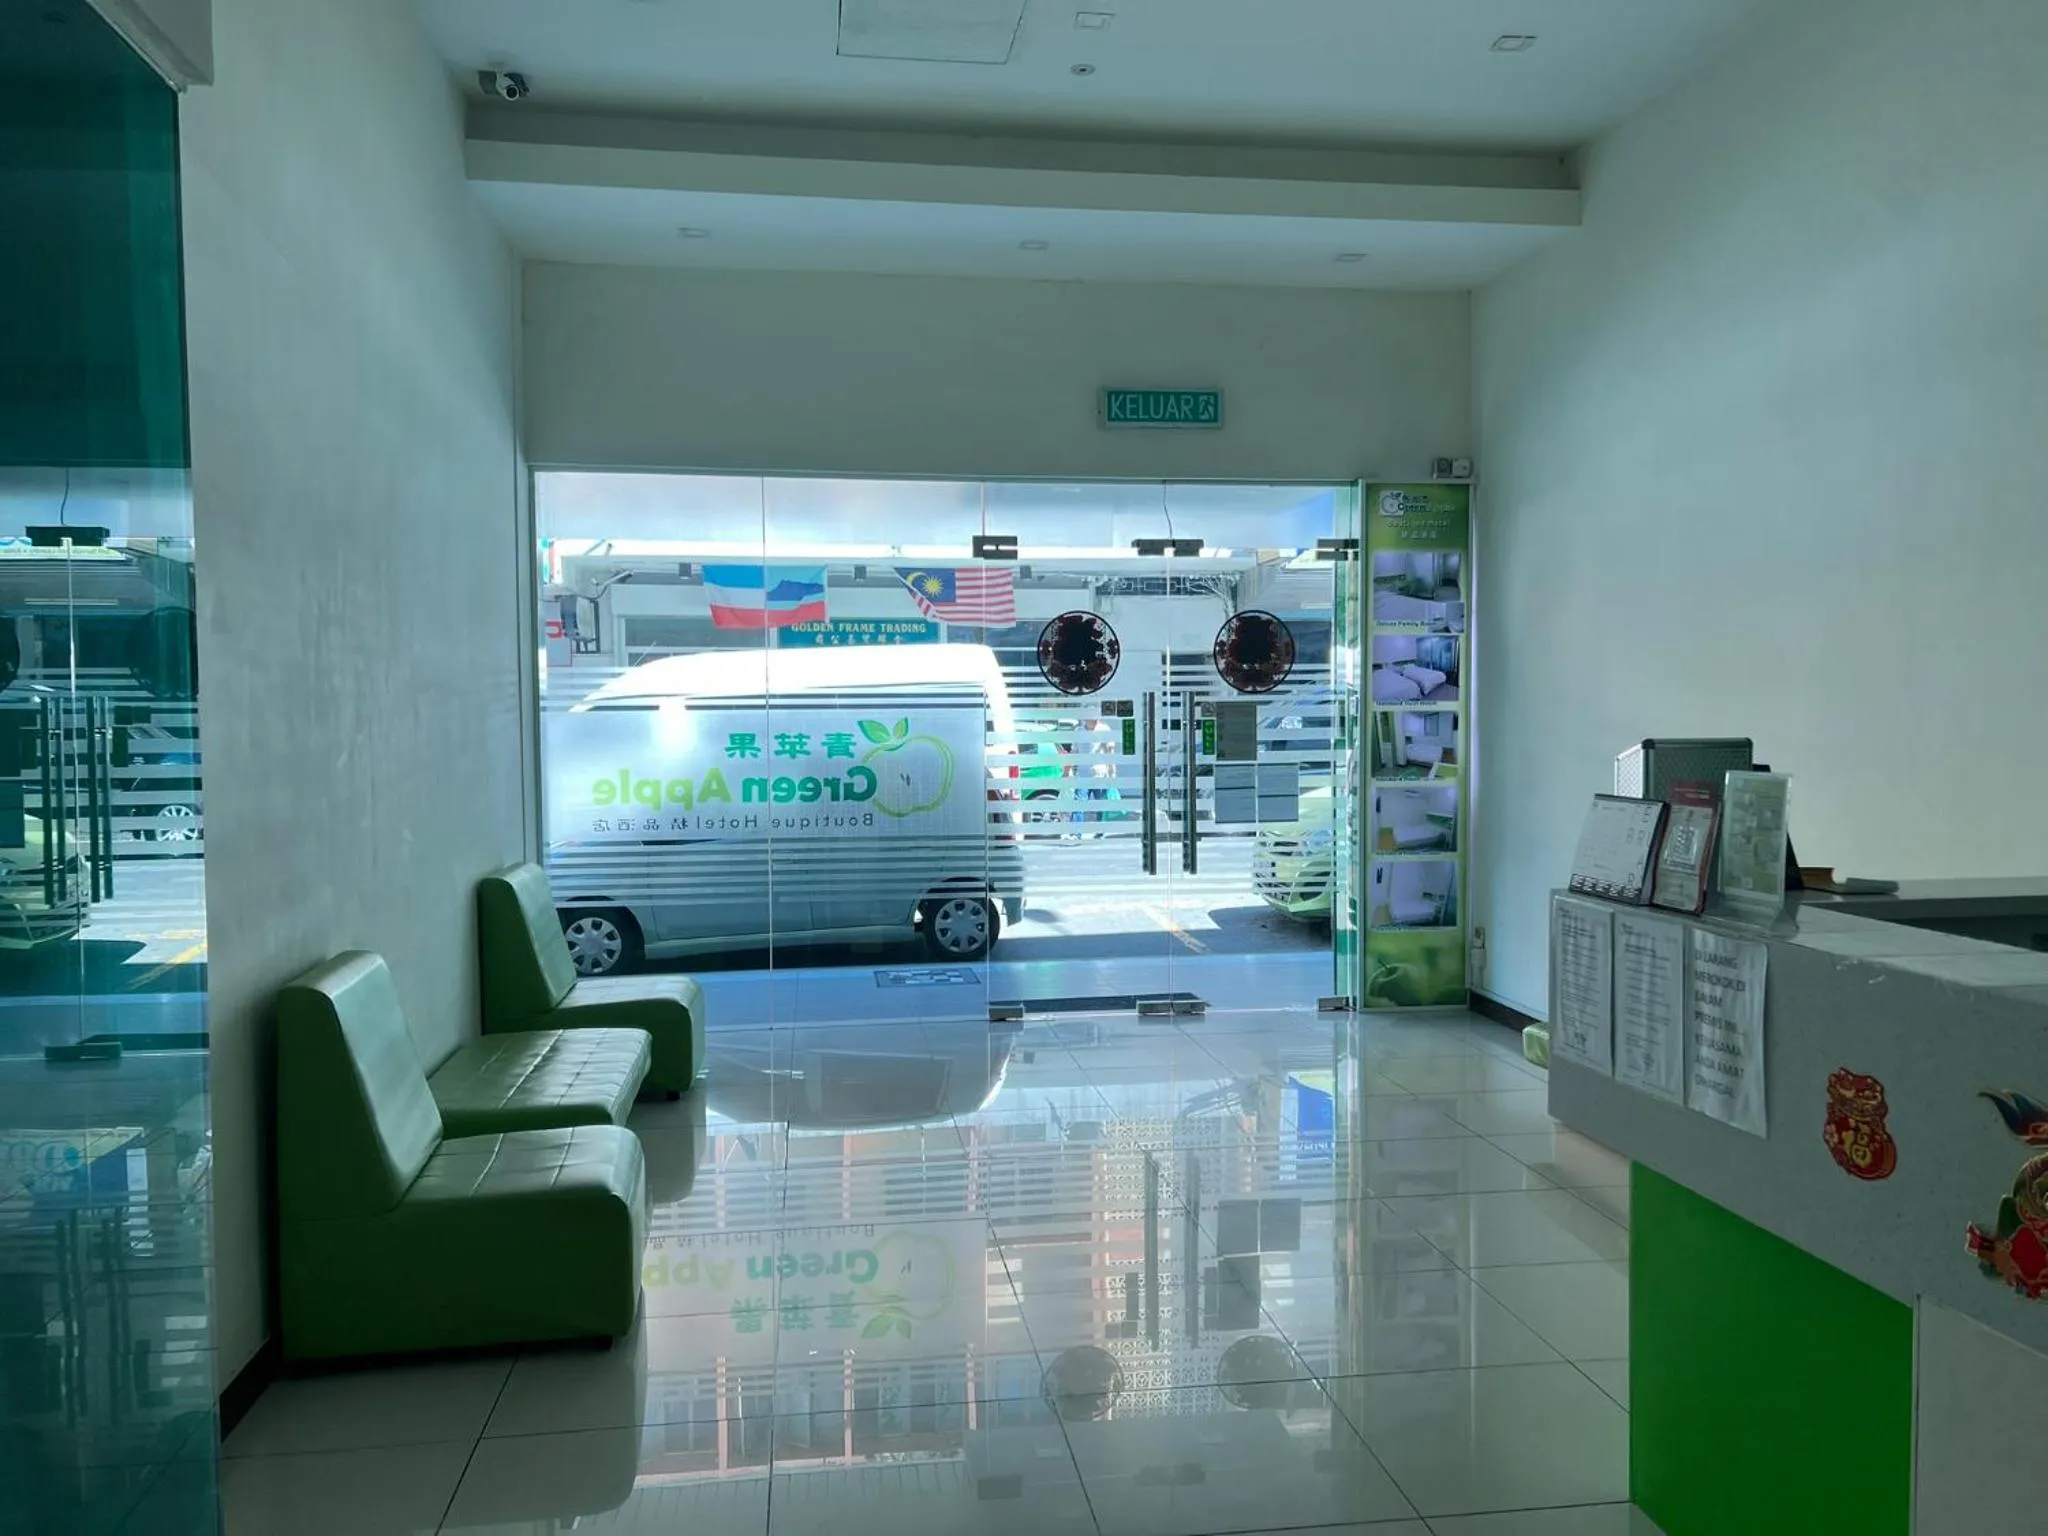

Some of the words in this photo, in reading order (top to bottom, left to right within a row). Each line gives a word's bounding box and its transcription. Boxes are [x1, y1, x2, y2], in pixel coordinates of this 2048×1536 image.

[1111, 393, 1194, 420] KELUAR
[791, 622, 834, 633] GOLDEN
[839, 622, 875, 633] FRAME
[881, 623, 927, 633] TRADING
